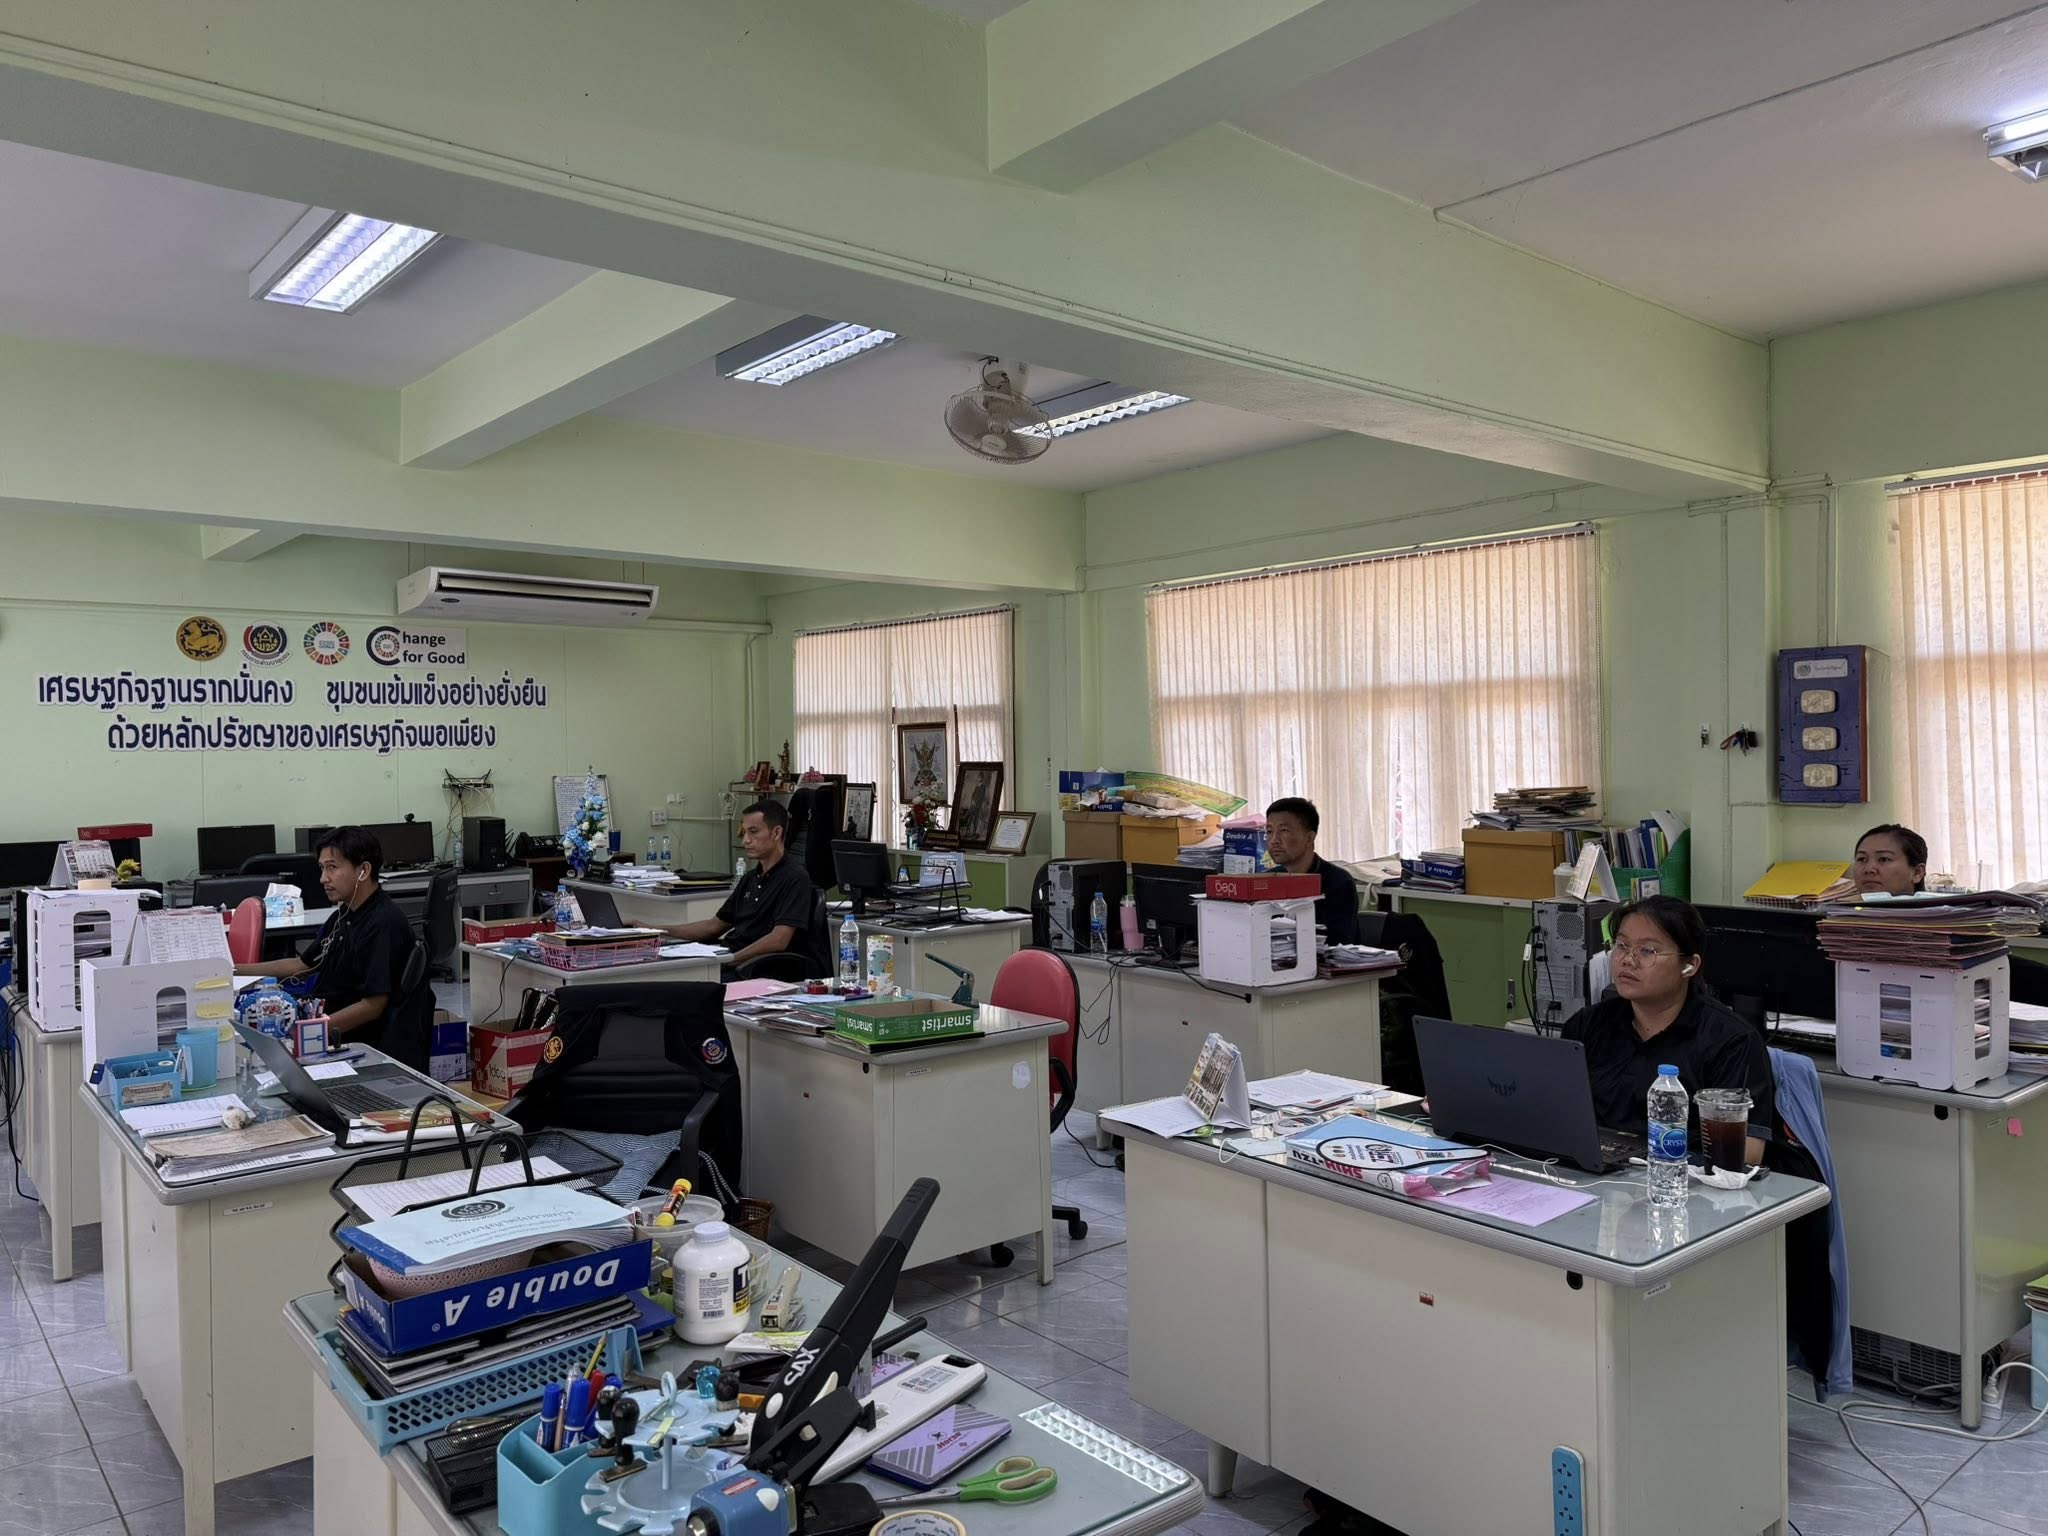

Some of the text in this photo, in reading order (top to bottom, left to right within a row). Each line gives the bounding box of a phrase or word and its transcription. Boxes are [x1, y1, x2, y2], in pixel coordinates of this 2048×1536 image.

[402, 649, 465, 664] for Good
[39, 663, 546, 712] เศรษฐกิจฐานรากมั่นคง ชุมชนเข้มแข็งอย่างยั่งยืน
[108, 714, 496, 754] ด้วยหลักปรัชญาของเศรษฐกิจพอเพียง
[846, 1016, 873, 1032] smartist
[921, 1014, 972, 1033] smartist
[443, 1258, 621, 1327] Double A
[784, 1346, 821, 1386] SAX
